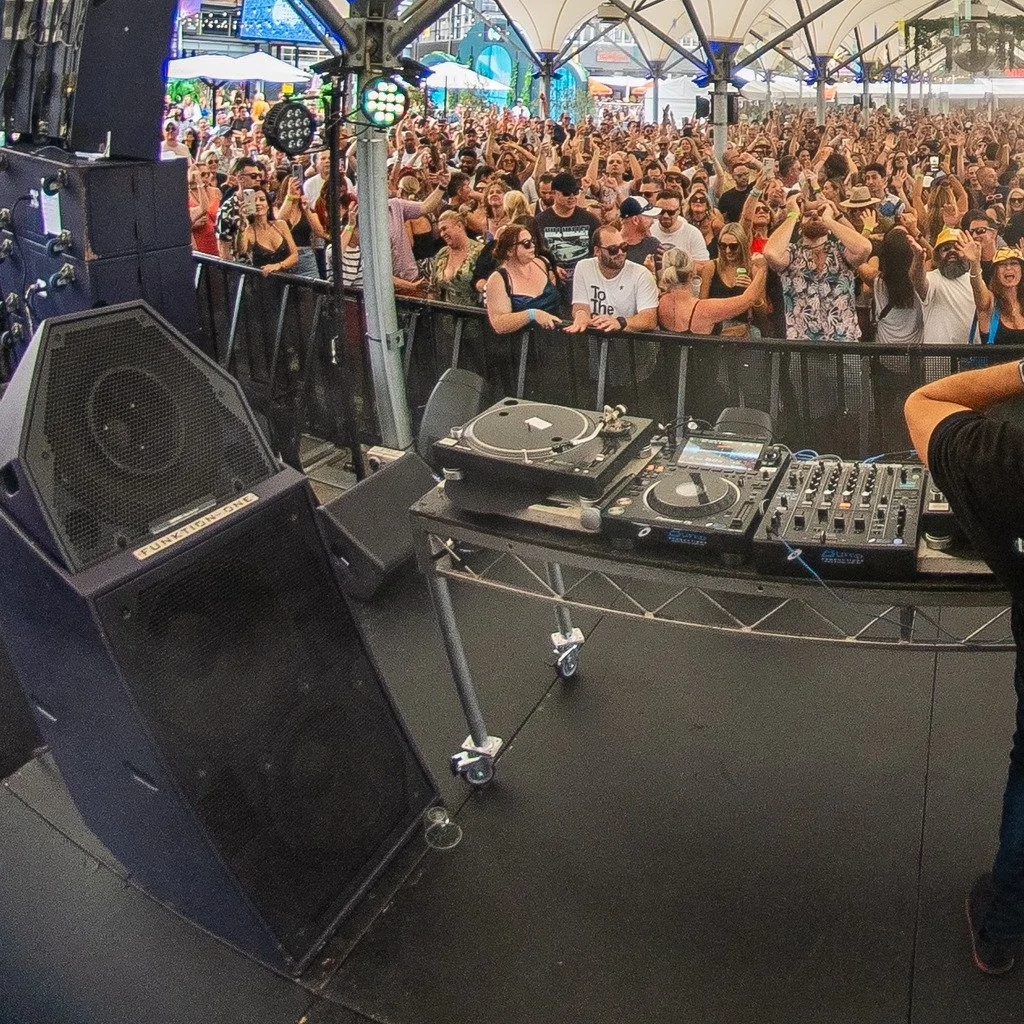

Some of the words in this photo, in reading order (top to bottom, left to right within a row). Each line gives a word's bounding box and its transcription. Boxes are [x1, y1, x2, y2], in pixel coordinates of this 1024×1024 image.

[590, 285, 606, 301] To
[590, 298, 614, 316] The
[140, 495, 254, 557] FUNKTION-ONE
